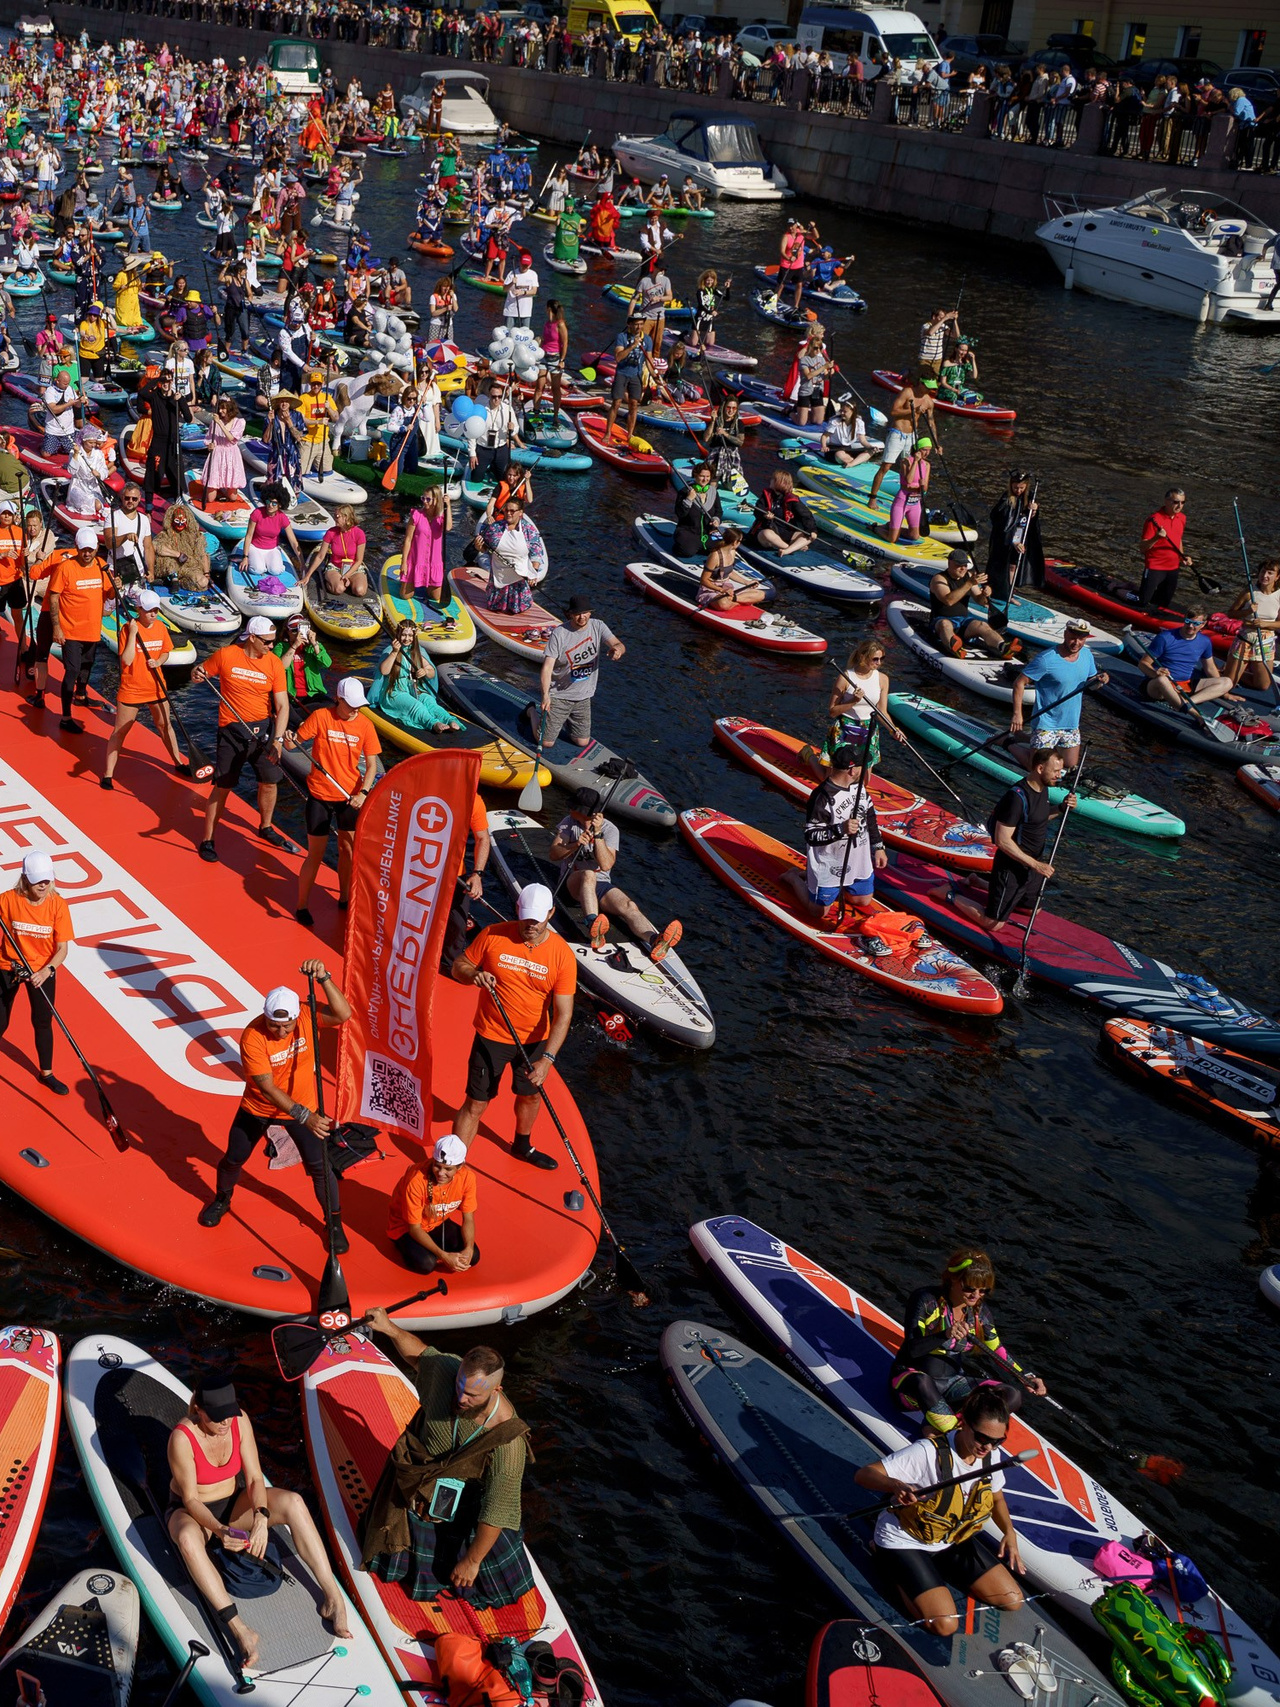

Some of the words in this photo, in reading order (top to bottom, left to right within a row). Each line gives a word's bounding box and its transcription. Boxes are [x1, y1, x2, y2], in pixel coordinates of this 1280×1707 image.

[514, 334, 529, 343] SUP
[494, 346, 509, 357] SUP
[496, 961, 548, 981] онлайн-журнал
[1198, 1057, 1246, 1084] DRIVE
[1092, 1481, 1119, 1534] GLADIATOR
